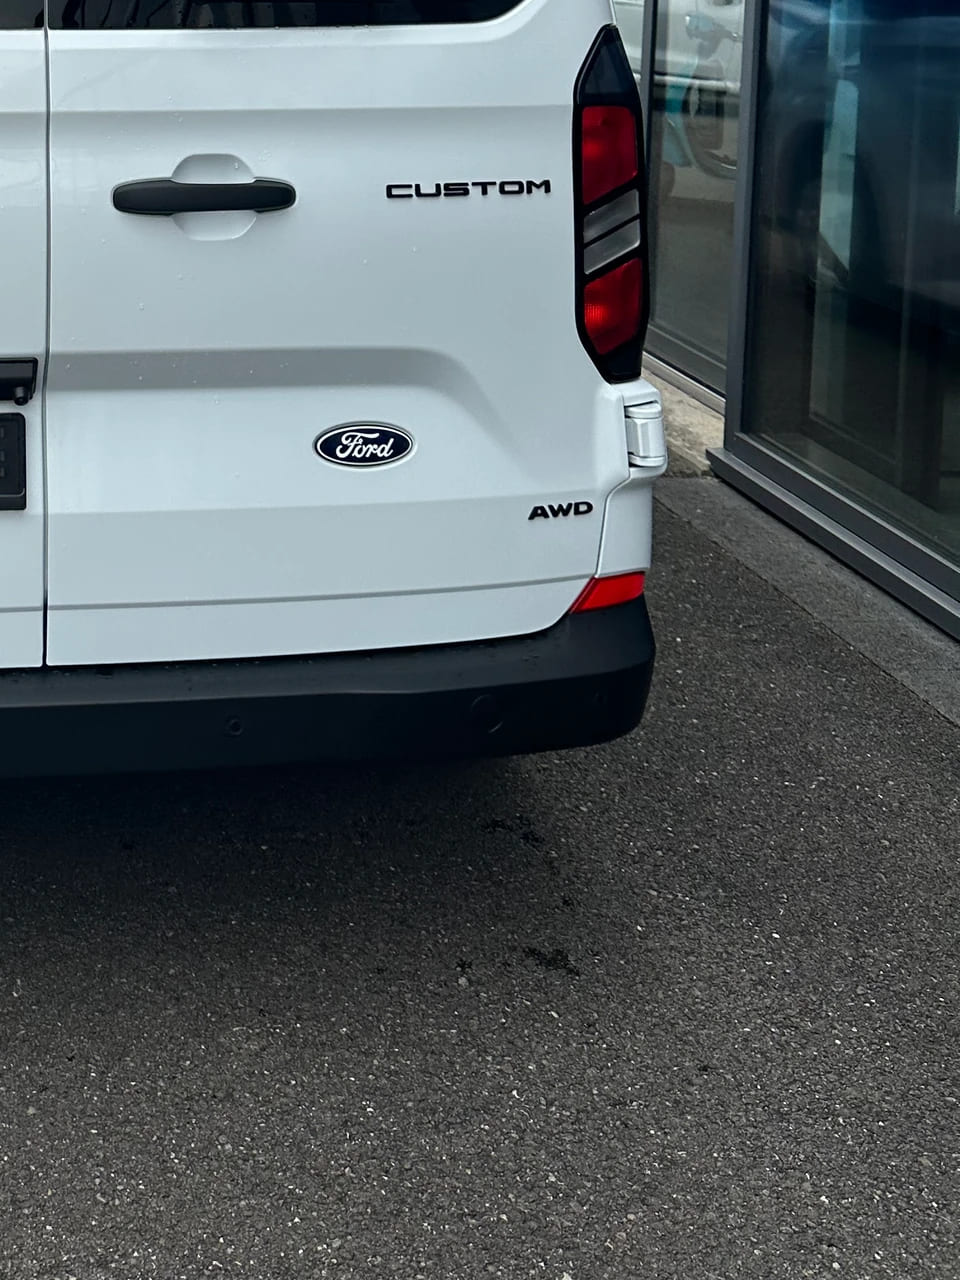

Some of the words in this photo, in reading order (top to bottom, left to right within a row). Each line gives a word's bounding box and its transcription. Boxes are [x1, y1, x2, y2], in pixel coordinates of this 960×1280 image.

[386, 179, 552, 199] CUSTOM
[336, 431, 394, 458] Ford
[528, 501, 593, 520] AWD
